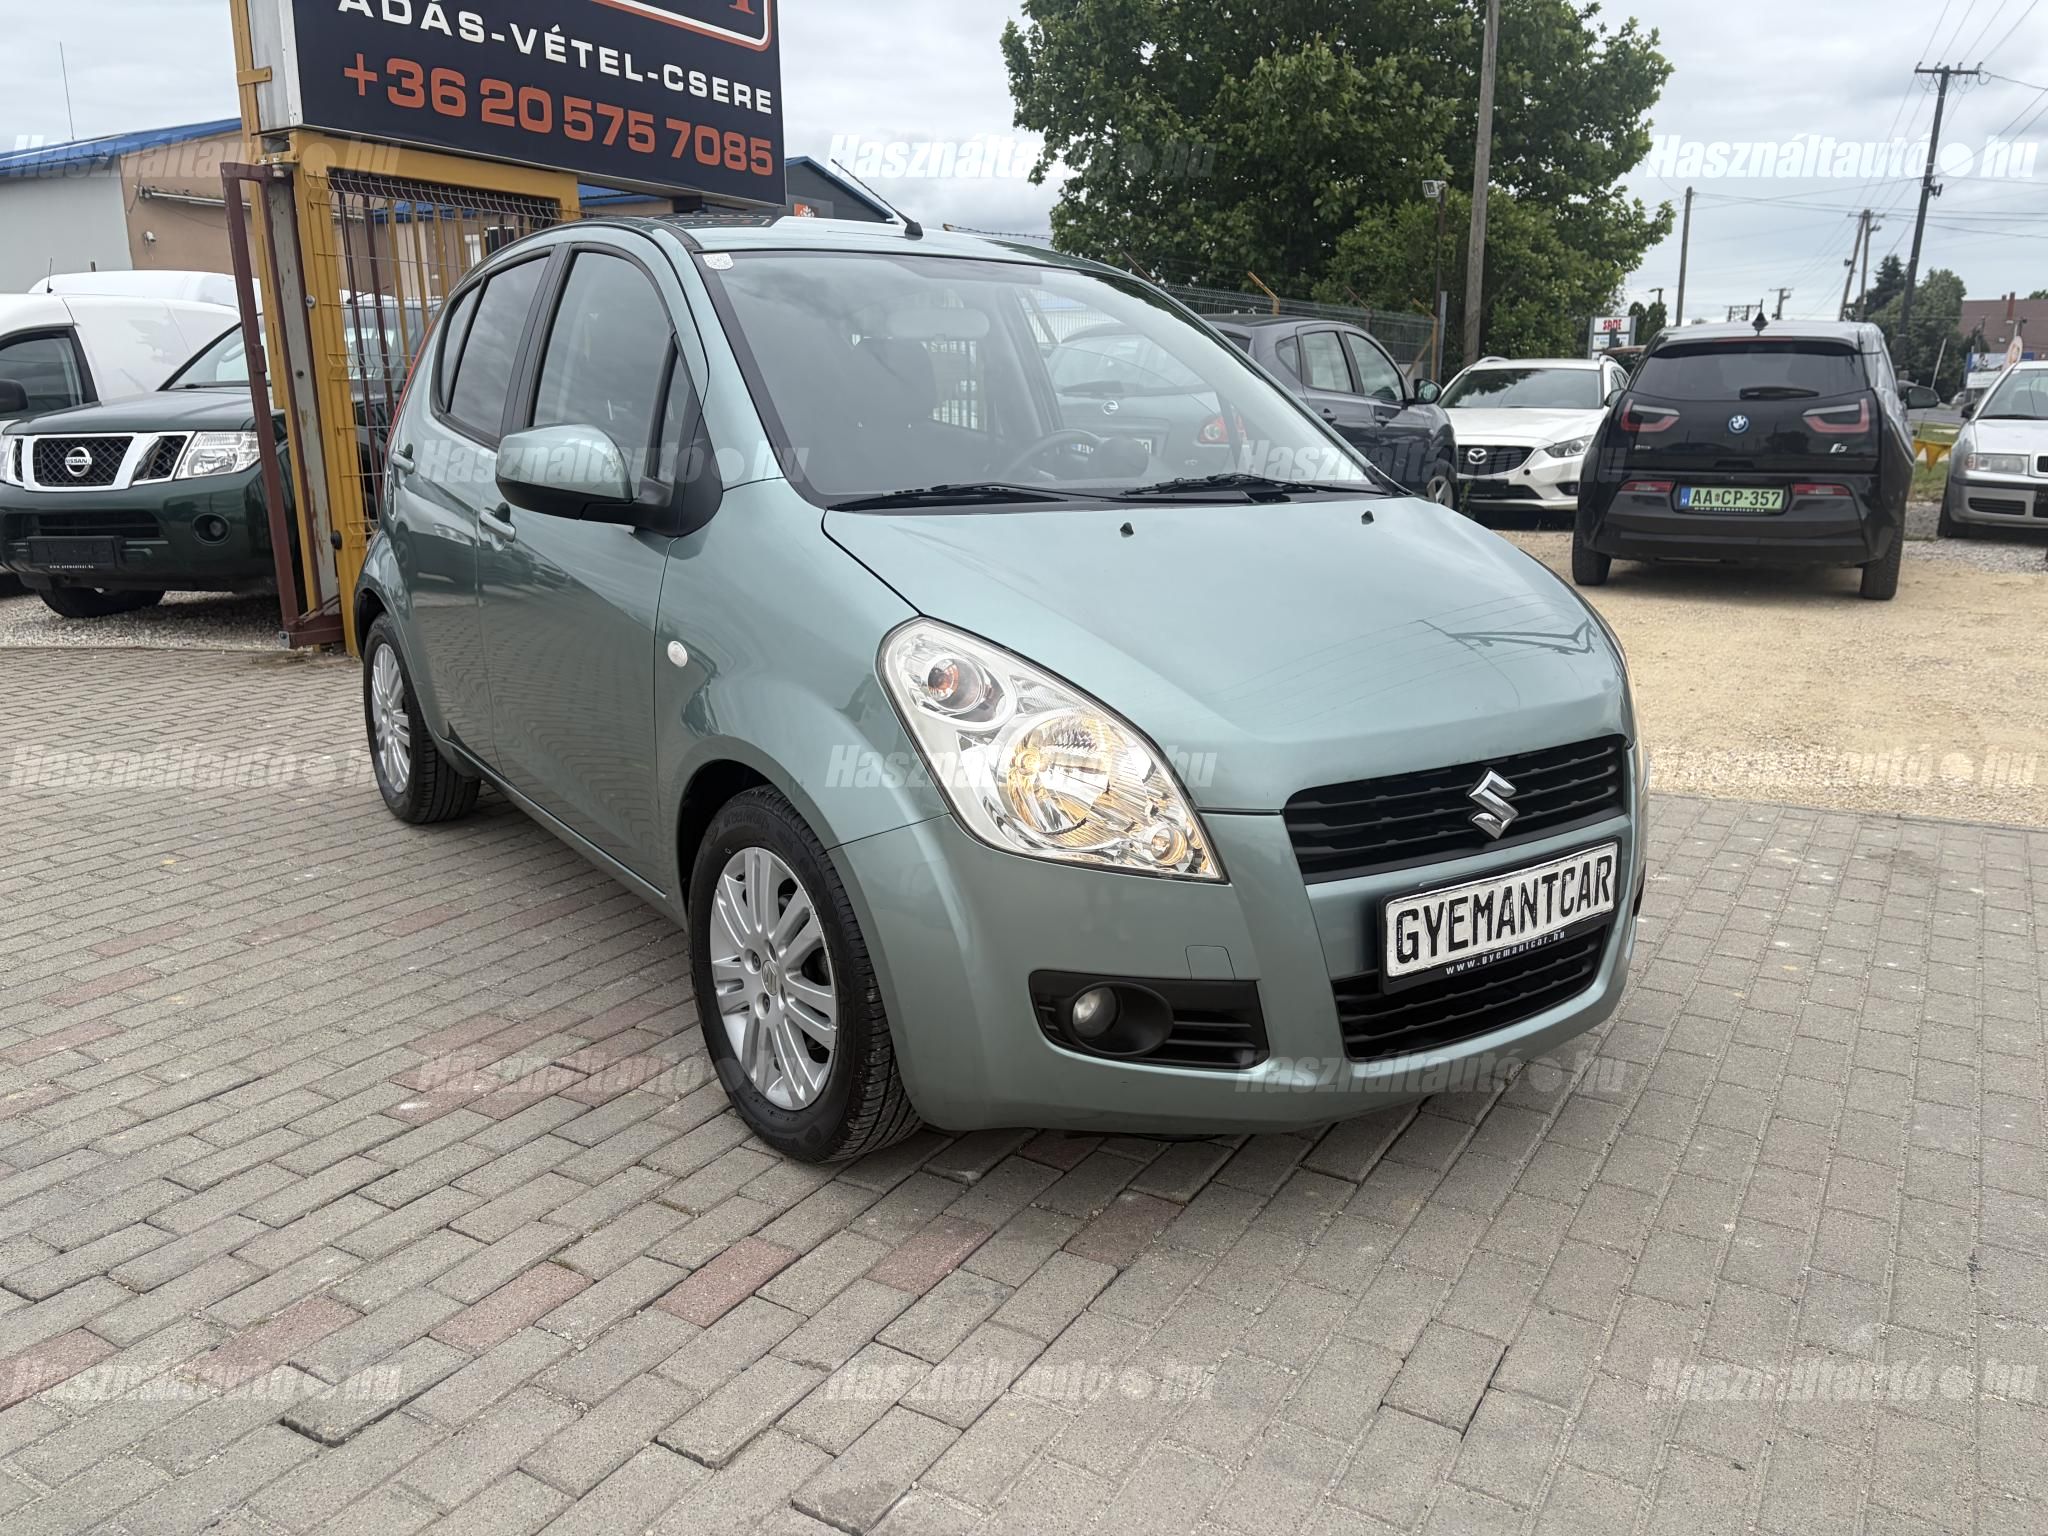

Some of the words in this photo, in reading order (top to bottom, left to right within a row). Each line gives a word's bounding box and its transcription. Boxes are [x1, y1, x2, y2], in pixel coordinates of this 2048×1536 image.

[344, 53, 467, 117] +36
[480, 78, 553, 133] 20
[563, 95, 656, 153] 575
[666, 117, 774, 176] 7085
[1692, 489, 1713, 505] AA
[1721, 490, 1781, 506] CP-357
[1396, 854, 1613, 965] GYEMANTCAR
[1446, 930, 1565, 975] www.gyemantcar.hu
